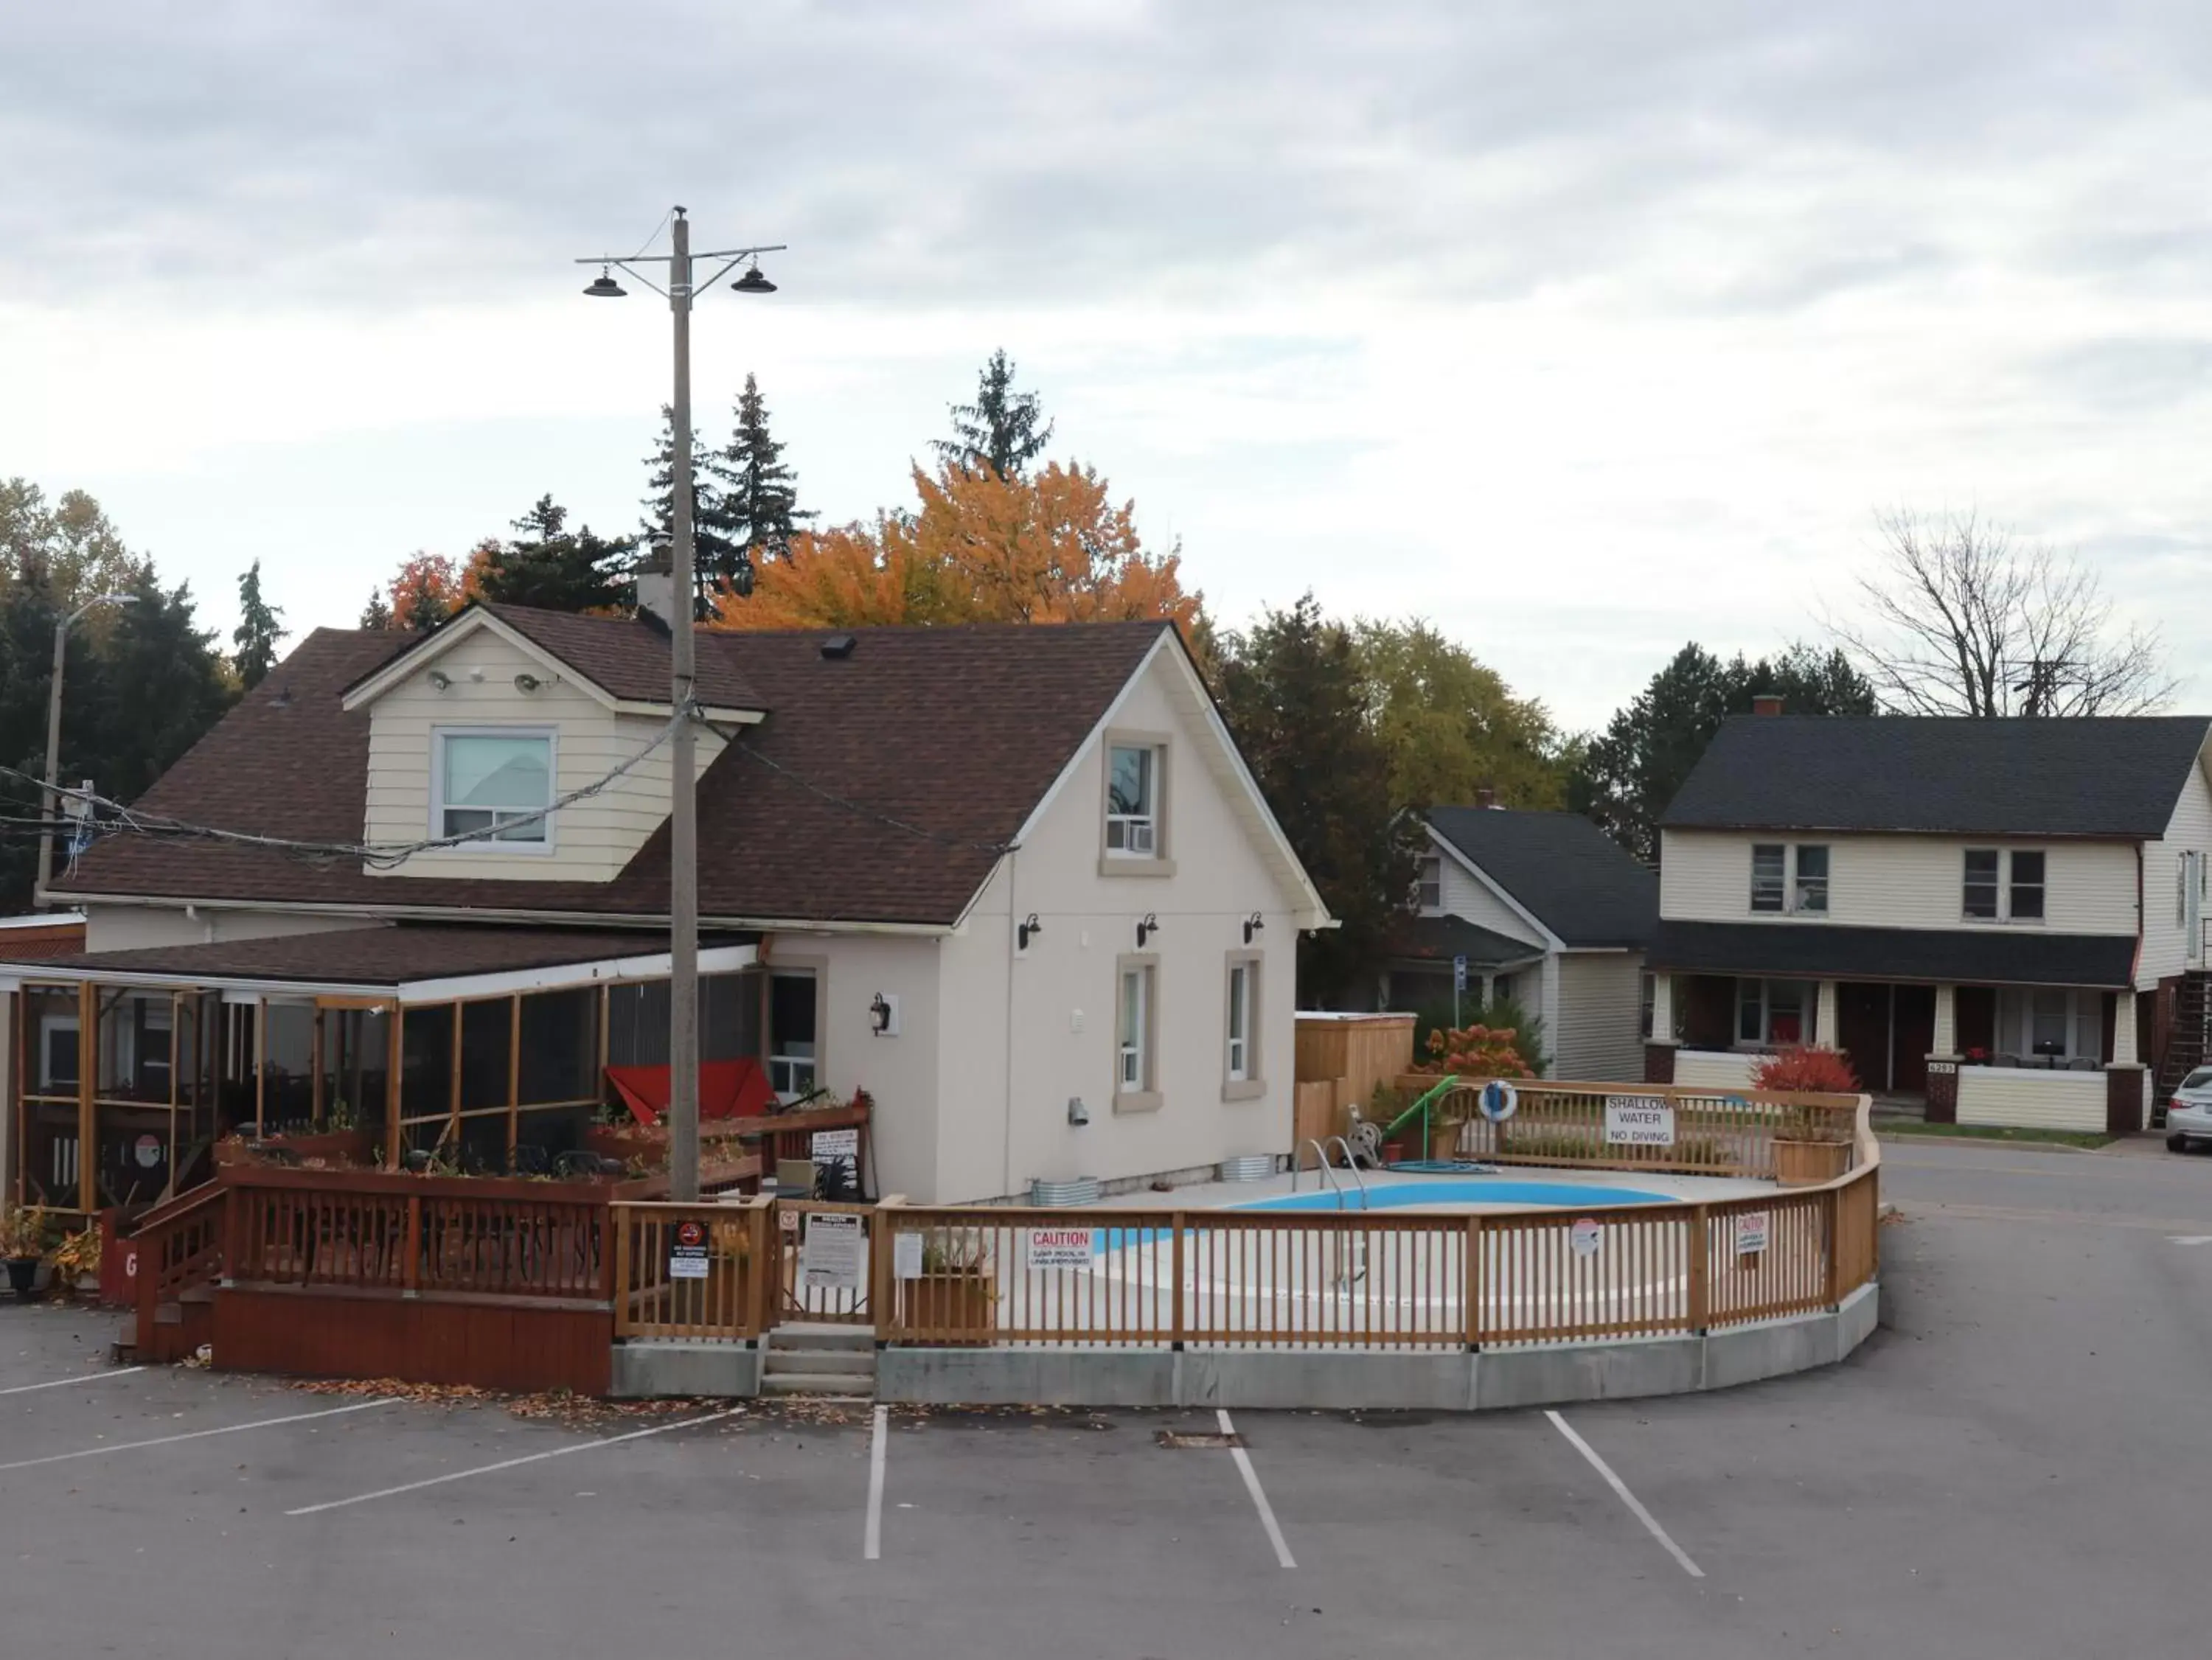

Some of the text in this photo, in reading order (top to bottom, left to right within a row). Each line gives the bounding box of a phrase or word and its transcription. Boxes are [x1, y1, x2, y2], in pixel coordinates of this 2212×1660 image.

[1609, 1097, 1669, 1110] SHALLOW
[1618, 1112, 1661, 1126] WATER
[1611, 1131, 1669, 1143] NO DIVING
[1034, 1232, 1089, 1246] CAUTION
